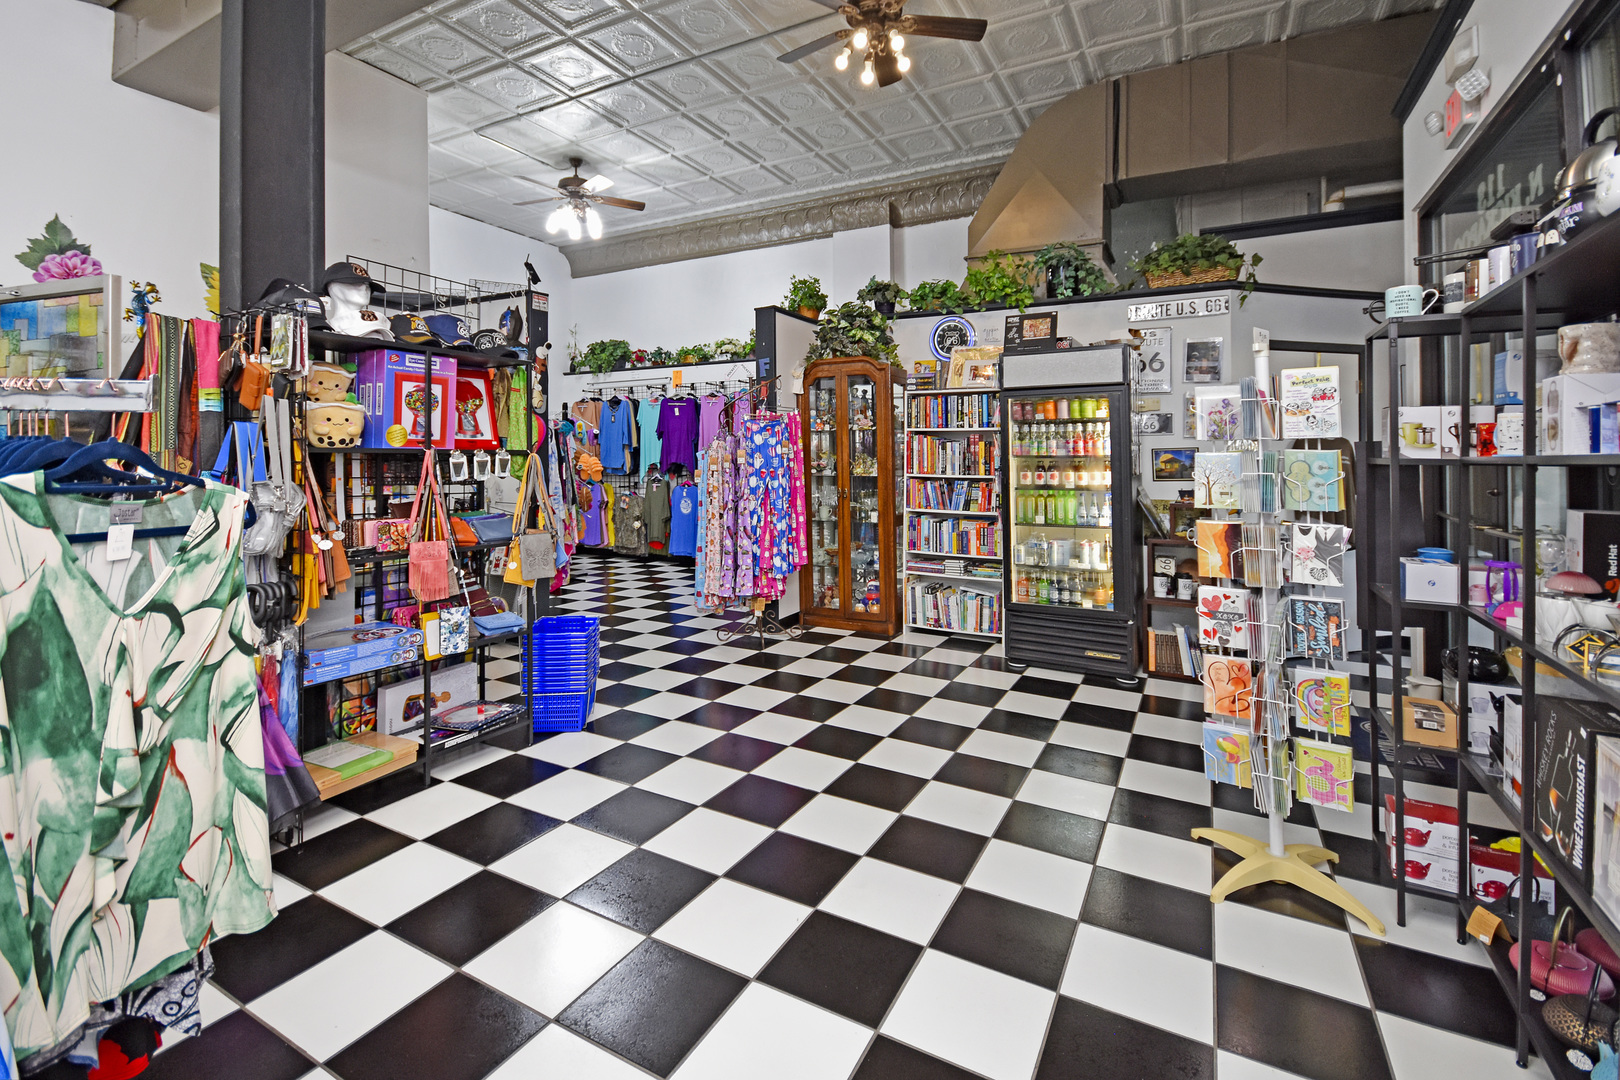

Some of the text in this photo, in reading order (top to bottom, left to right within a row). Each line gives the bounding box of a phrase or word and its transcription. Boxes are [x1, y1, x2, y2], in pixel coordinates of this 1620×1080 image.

[1176, 300, 1199, 315] U.S.
[1205, 298, 1222, 313] 66
[758, 357, 770, 378] F
[1291, 379, 1315, 387] Perfect
[1143, 421, 1156, 430] 66
[1295, 600, 1305, 625] REASON
[1544, 709, 1557, 743] ROCKS
